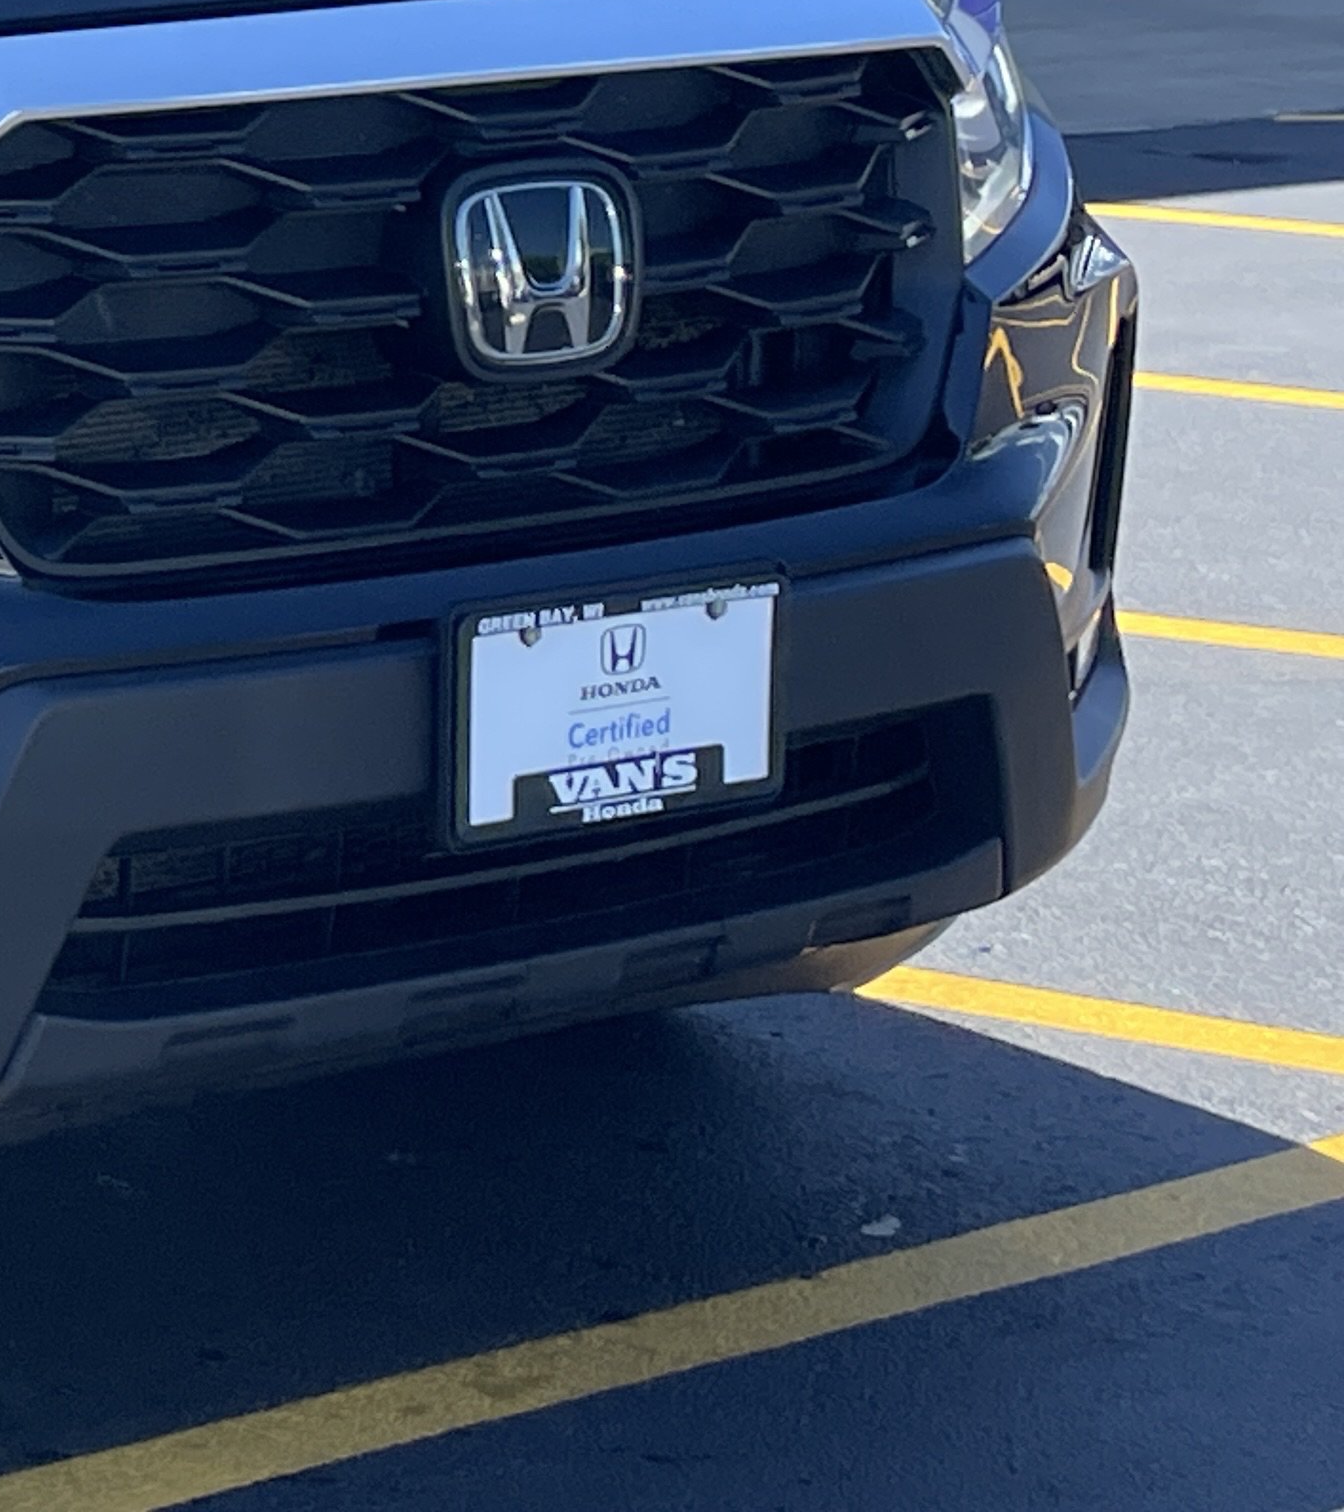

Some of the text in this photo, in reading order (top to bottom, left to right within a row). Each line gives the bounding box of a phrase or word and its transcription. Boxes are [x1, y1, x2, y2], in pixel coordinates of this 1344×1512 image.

[579, 675, 662, 701] HONDA
[567, 707, 672, 749] Certified
[581, 798, 665, 824] Honda
